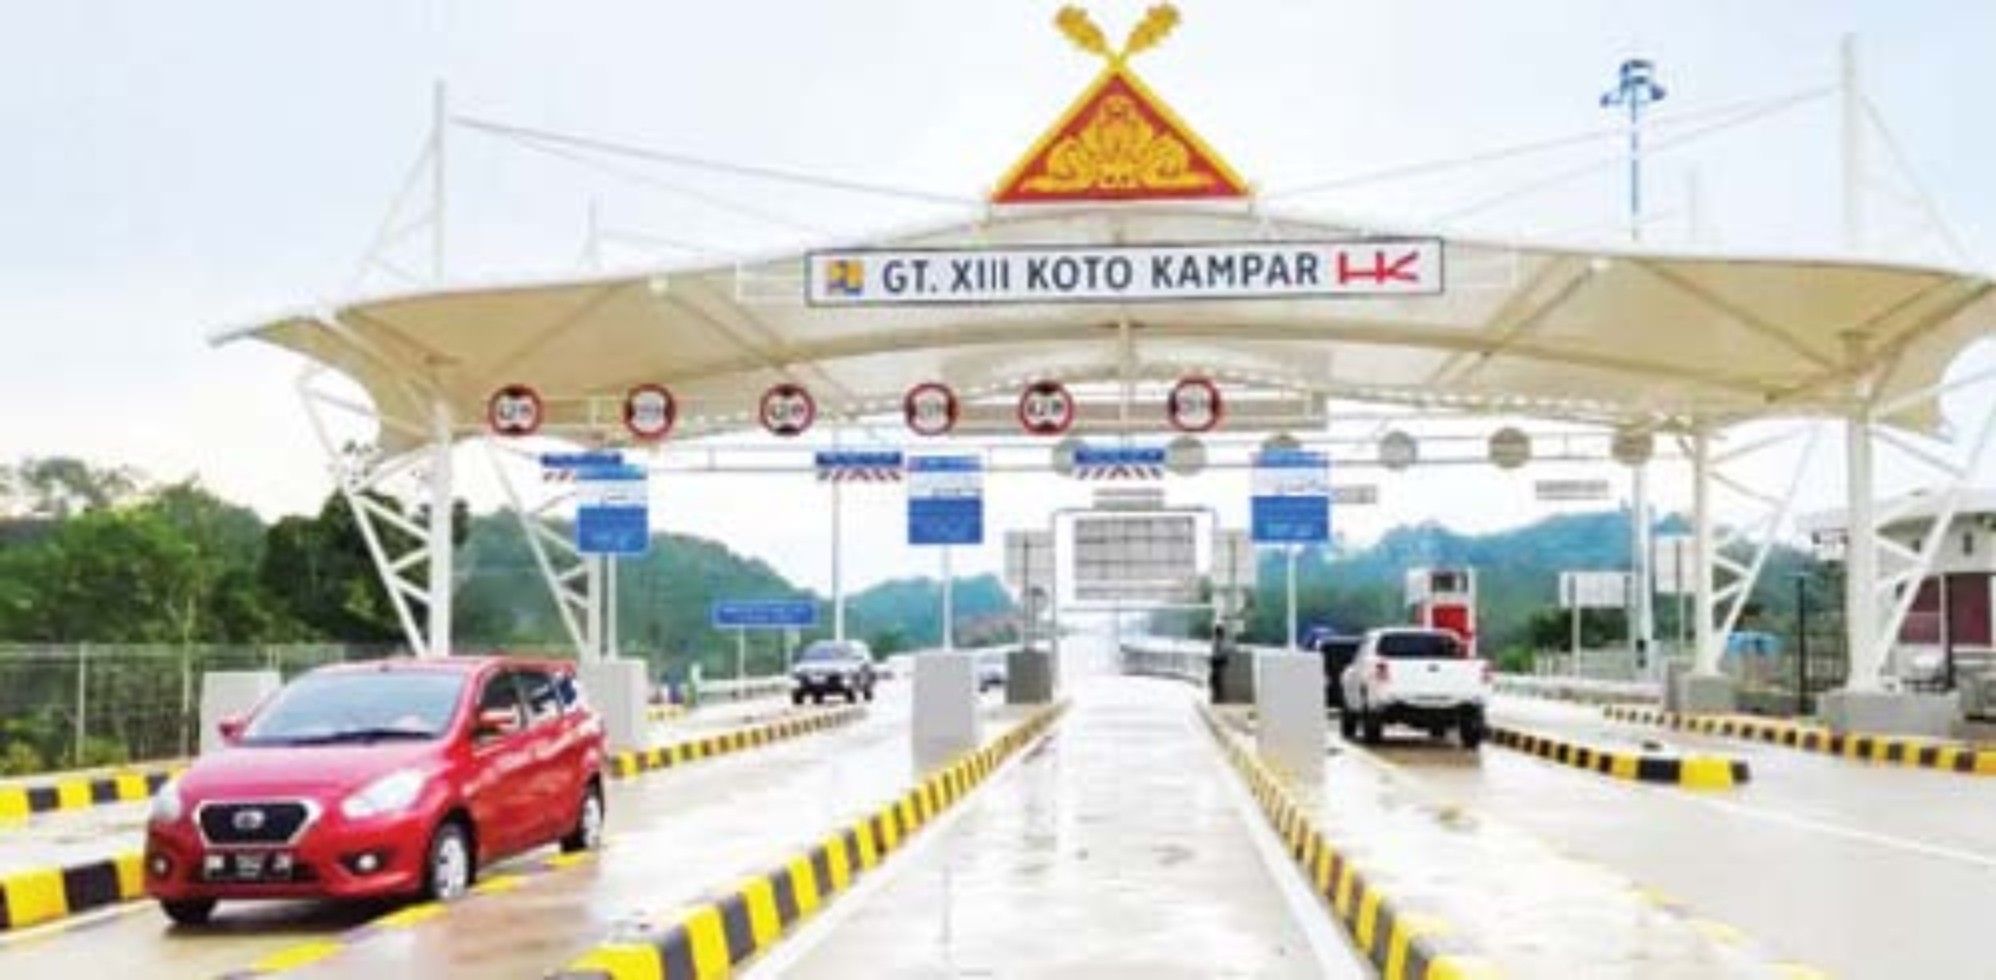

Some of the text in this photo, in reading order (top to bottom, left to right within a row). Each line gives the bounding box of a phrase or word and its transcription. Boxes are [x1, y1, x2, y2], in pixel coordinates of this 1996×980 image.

[882, 252, 1319, 294] GT. XIII KOTO KAMPAR
